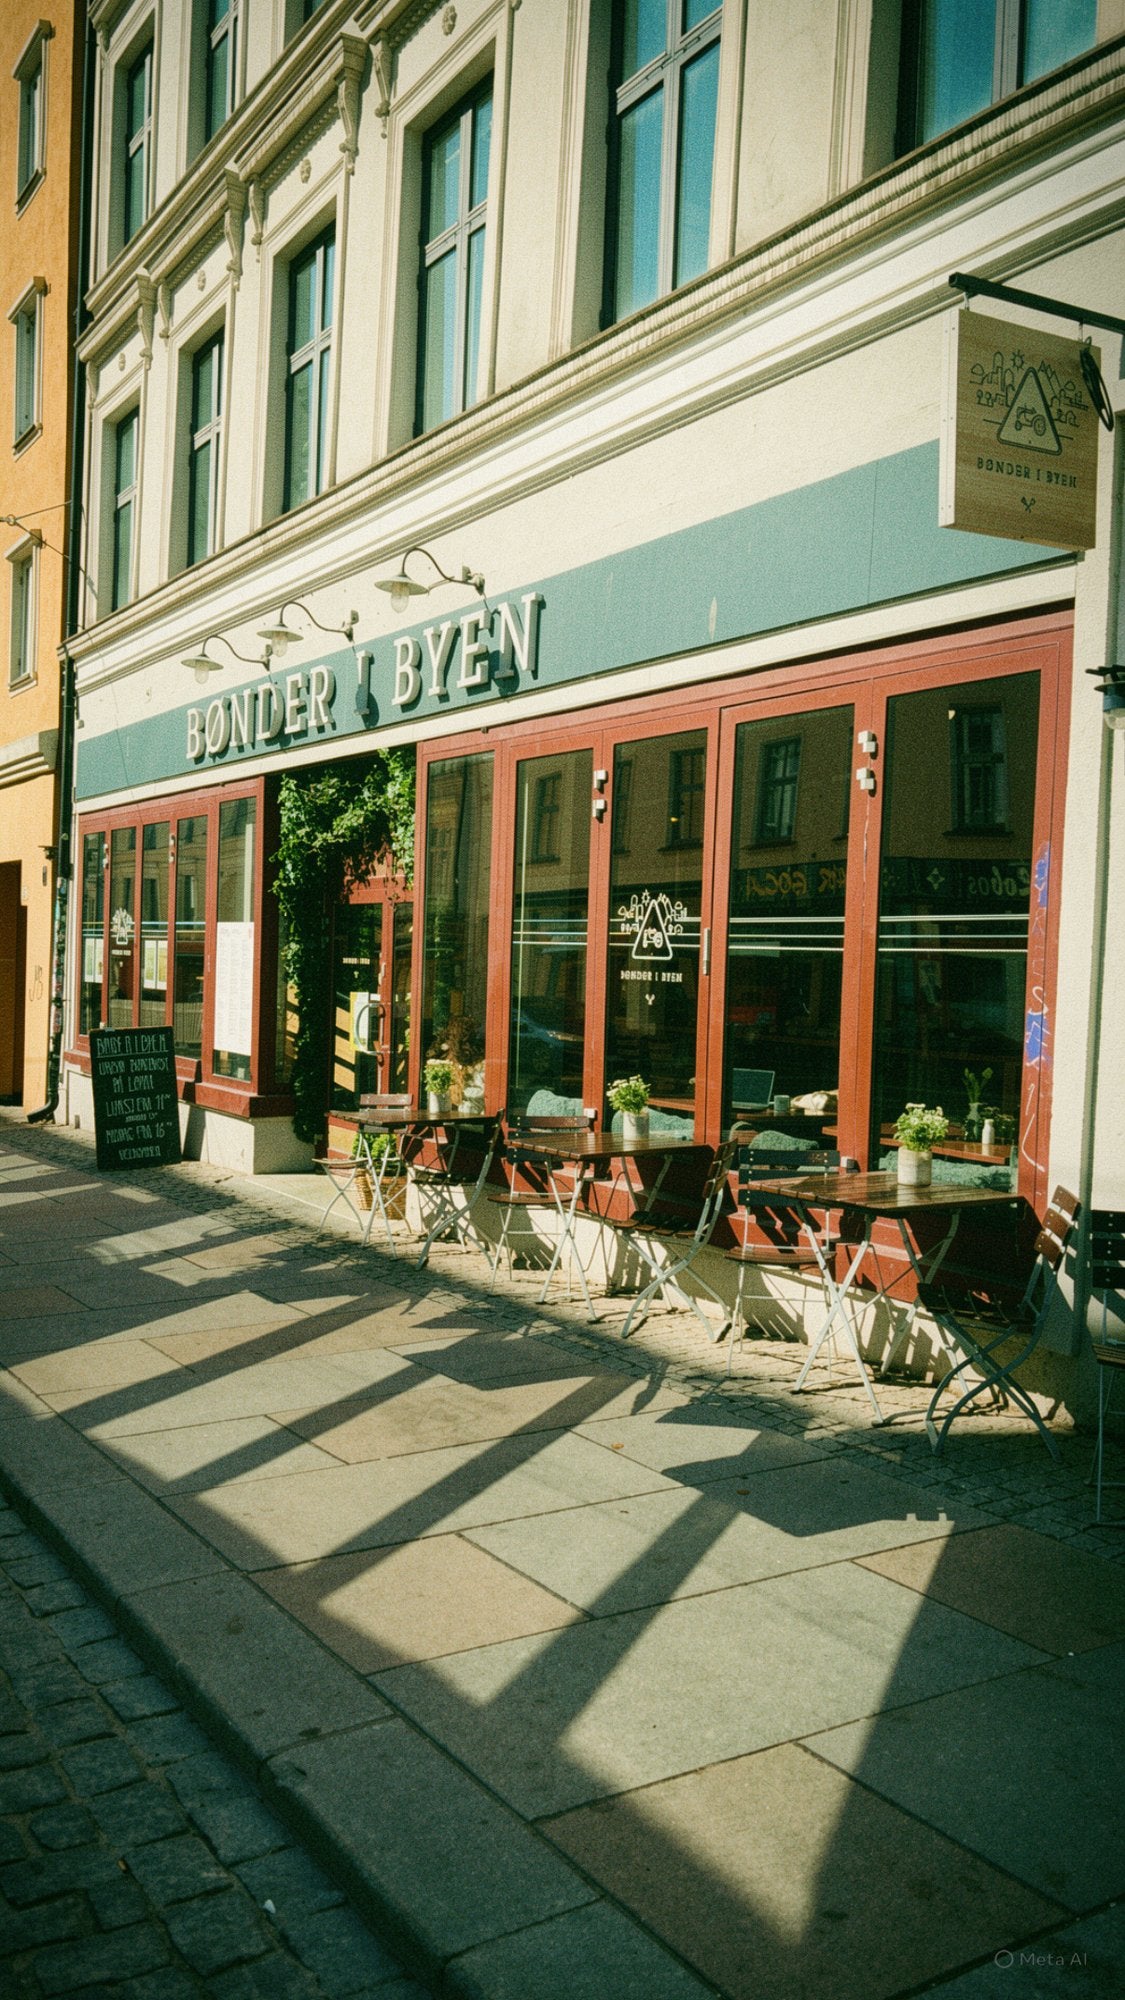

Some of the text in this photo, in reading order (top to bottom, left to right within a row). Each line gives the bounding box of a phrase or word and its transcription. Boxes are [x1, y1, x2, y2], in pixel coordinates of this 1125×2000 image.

[977, 457, 1077, 488] BØNDER I BYEN
[186, 592, 543, 760] BØNDER I BYEN
